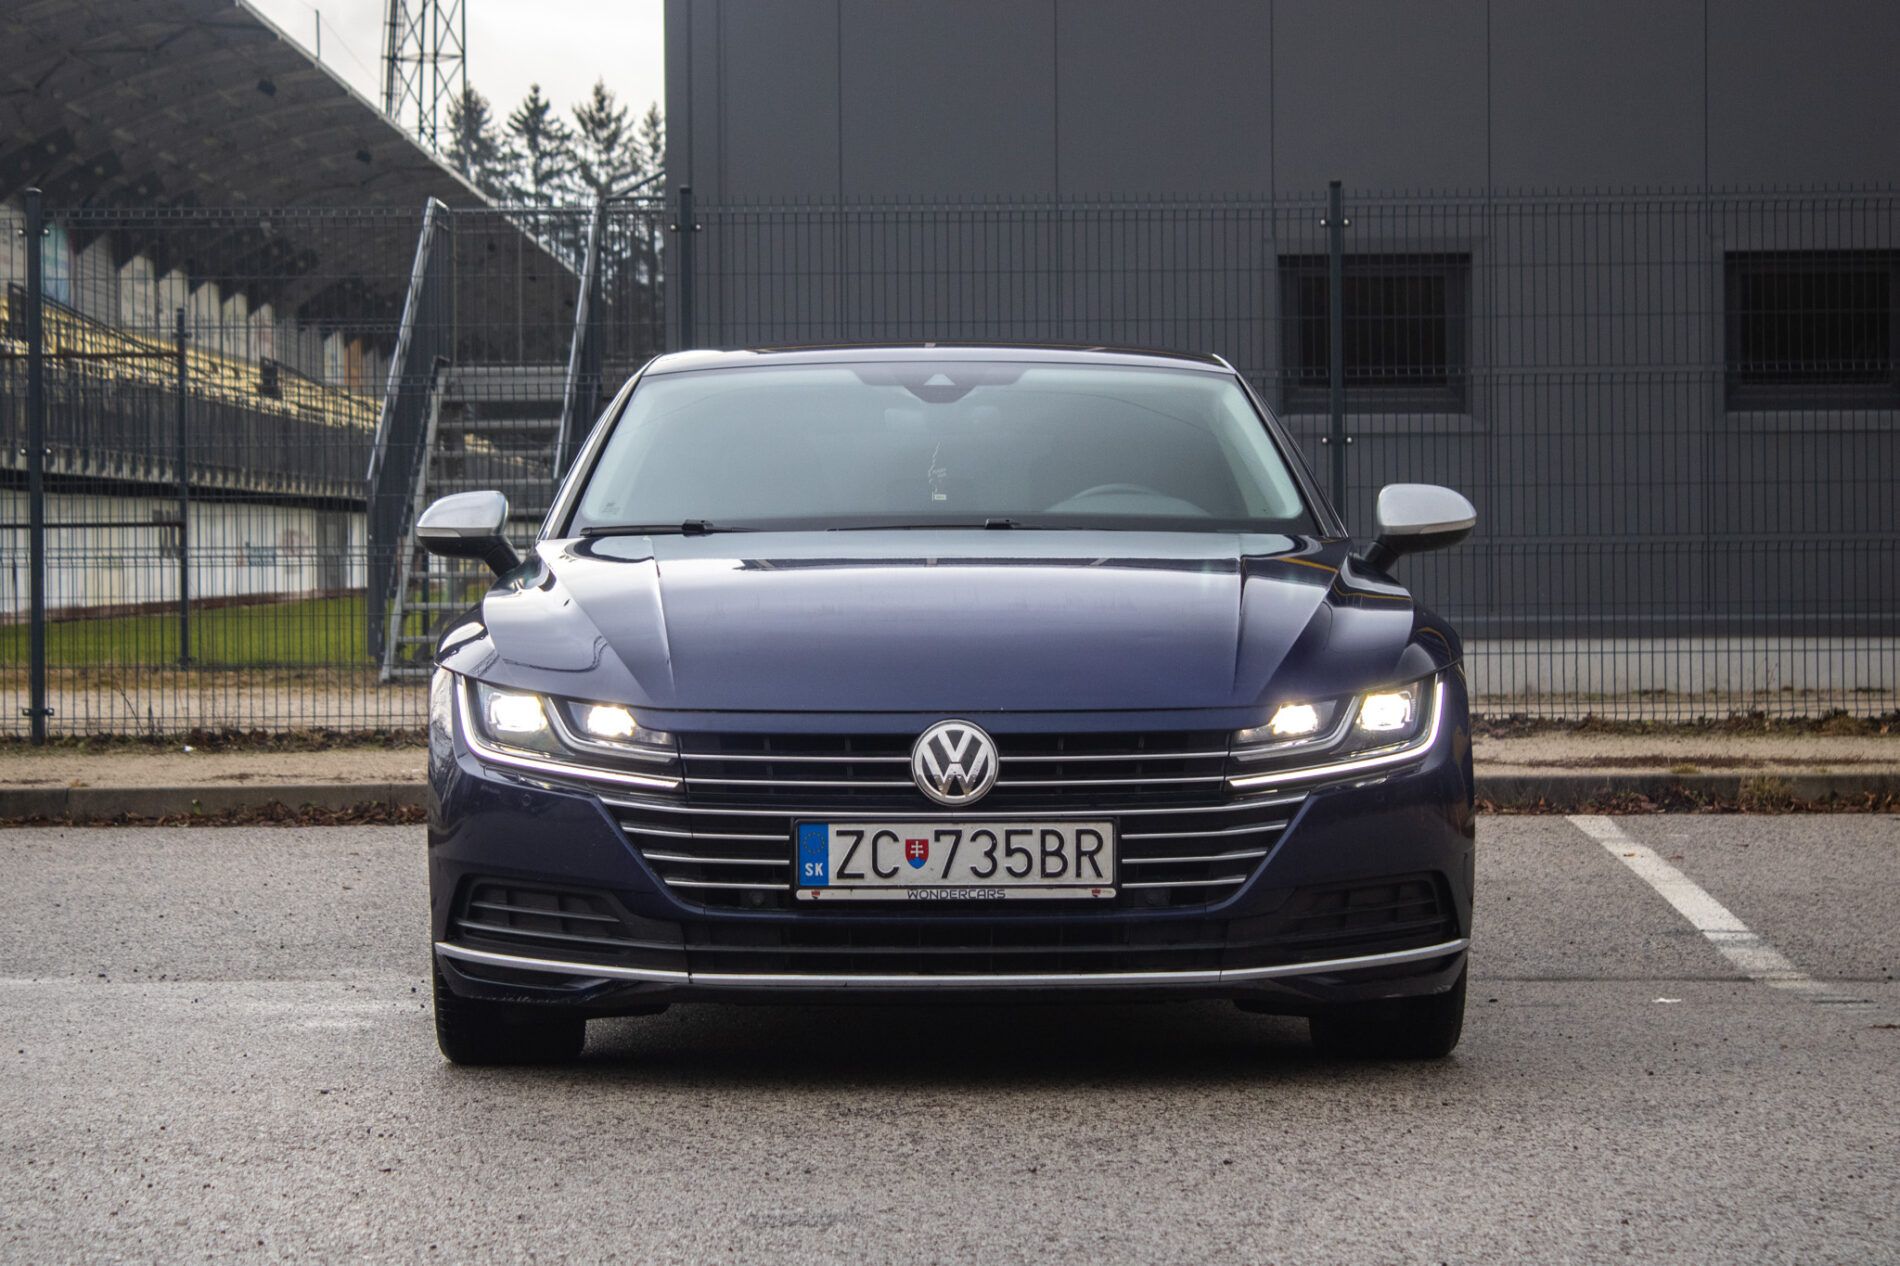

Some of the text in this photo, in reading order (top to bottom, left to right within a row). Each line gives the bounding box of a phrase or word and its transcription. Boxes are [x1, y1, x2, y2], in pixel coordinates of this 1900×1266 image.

[836, 828, 1104, 880] ZC 735BR
[805, 862, 824, 877] SK
[907, 888, 1006, 900] WONDERCARS
